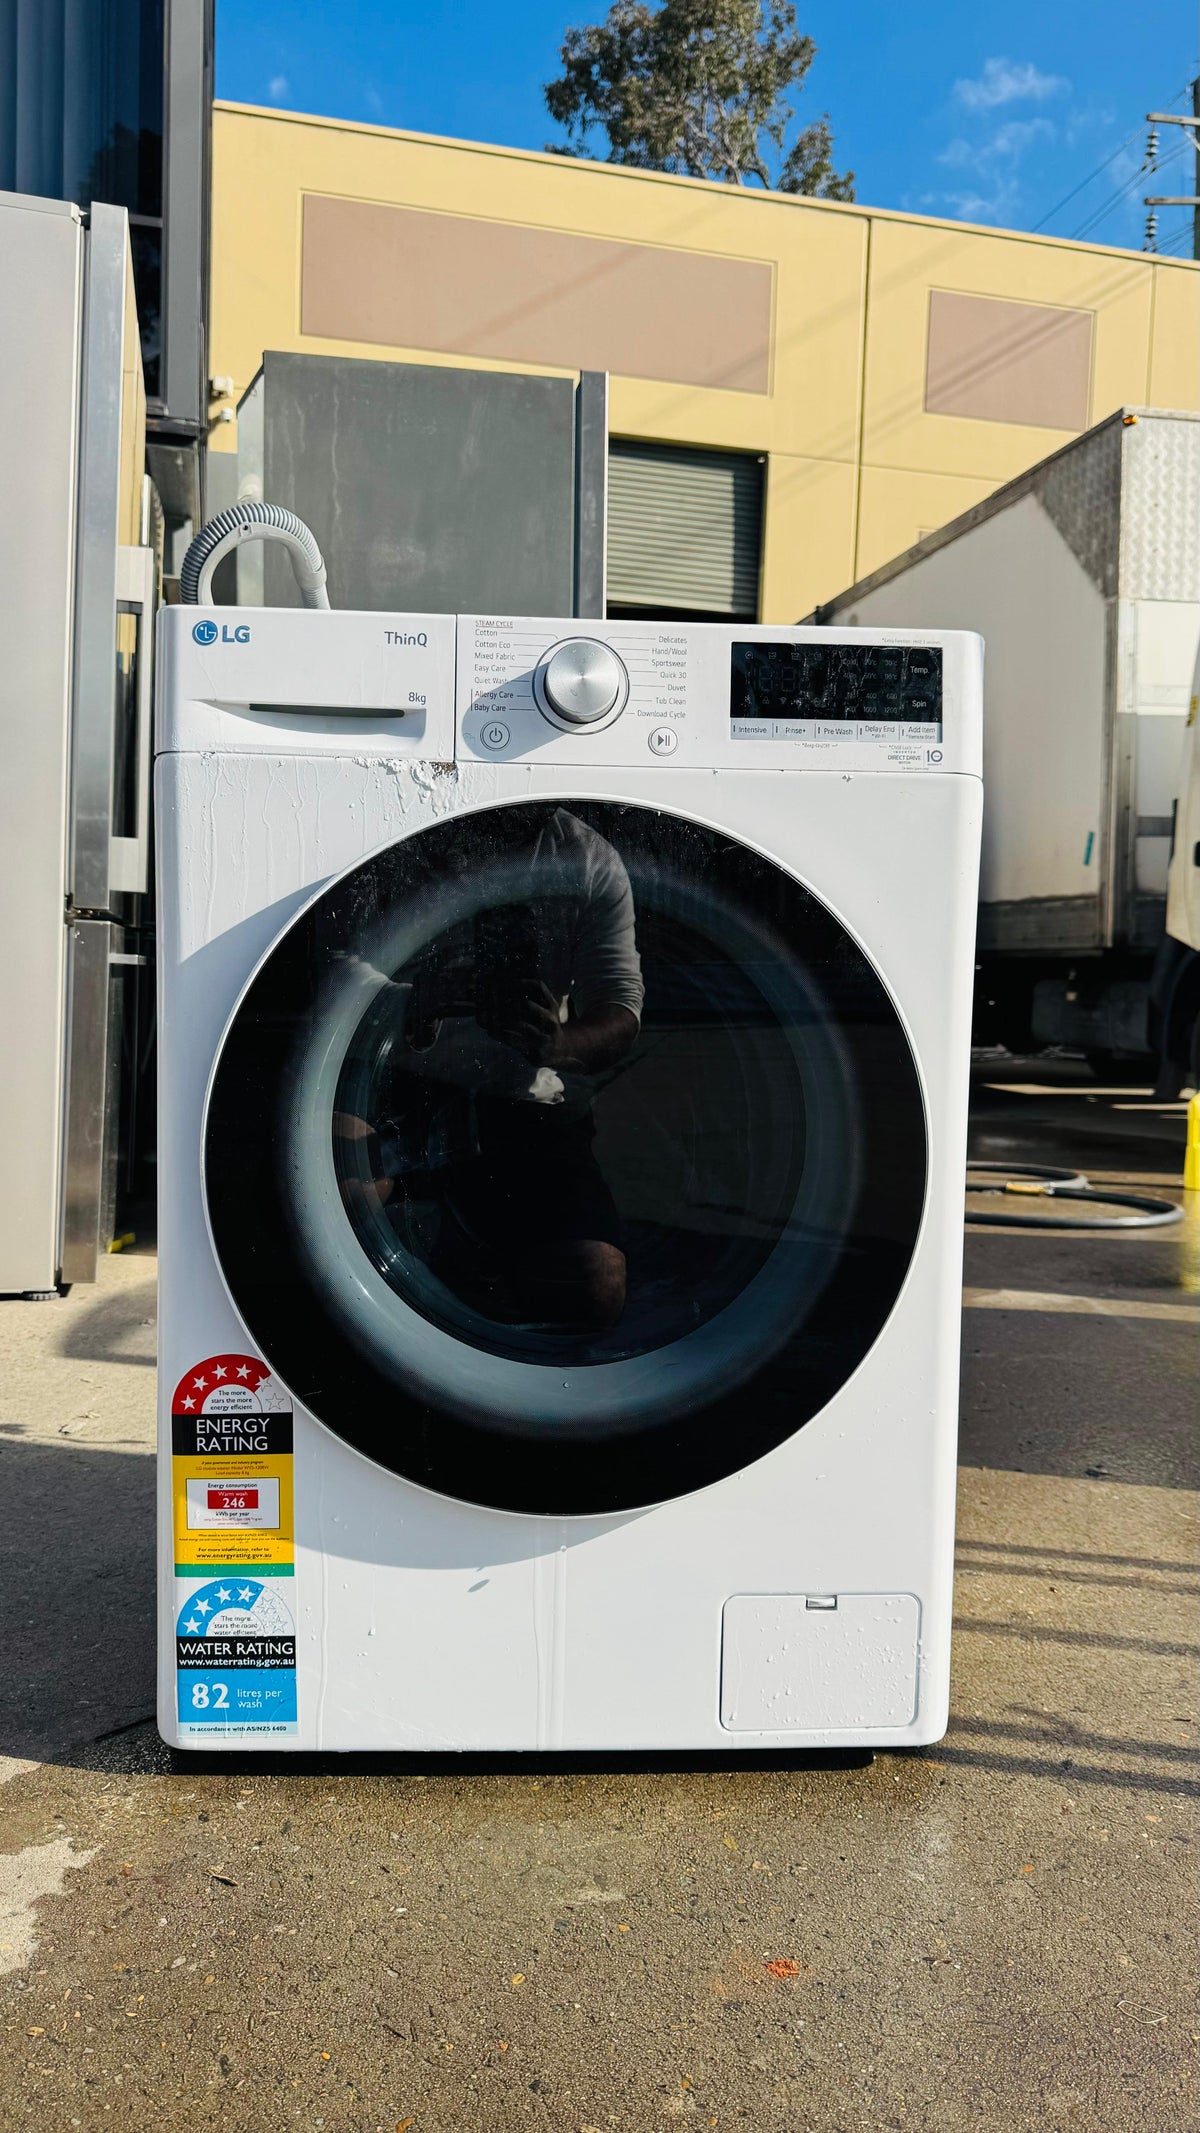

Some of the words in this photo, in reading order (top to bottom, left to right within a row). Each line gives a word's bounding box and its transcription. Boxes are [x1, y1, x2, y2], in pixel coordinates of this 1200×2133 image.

[222, 624, 251, 643] LG
[475, 629, 498, 637] Cotton
[384, 631, 428, 648] ThinQ
[658, 635, 688, 644] Delicates
[475, 640, 497, 648] Cotton
[499, 641, 511, 649] Eco
[475, 652, 494, 660] Mixed
[651, 647, 688, 656] Hand/Wool
[651, 659, 687, 668] Sportswear
[474, 664, 490, 673] Easy
[491, 664, 506, 672] Care
[910, 666, 930, 675] Temp.
[660, 671, 677, 679] Quick
[678, 671, 687, 679] 30
[474, 676, 491, 684] Quiet
[667, 683, 687, 691] Duvet
[408, 691, 427, 705] 8kg
[475, 690, 497, 700] Allergy
[656, 697, 667, 705] Tub
[668, 697, 687, 705] Clean
[912, 699, 927, 708] Spin
[474, 703, 490, 712] Baby
[637, 709, 668, 718] Download
[669, 710, 686, 719] Cycle
[738, 726, 767, 734] Intensive
[823, 727, 835, 735] Pre
[835, 727, 853, 736] Wash
[865, 725, 882, 734] Delay
[883, 725, 895, 733] End
[196, 1418, 270, 1434] ENERGY
[196, 1436, 268, 1452] RATING
[222, 1497, 245, 1508] 246
[179, 1642, 232, 1655] WATER
[236, 1642, 294, 1655] RATING
[179, 1658, 295, 1667] www.waterrating.gov.au
[191, 1683, 230, 1709] 82
[237, 1688, 262, 1698] litres
[265, 1690, 282, 1700] per
[238, 1699, 263, 1708] wash
